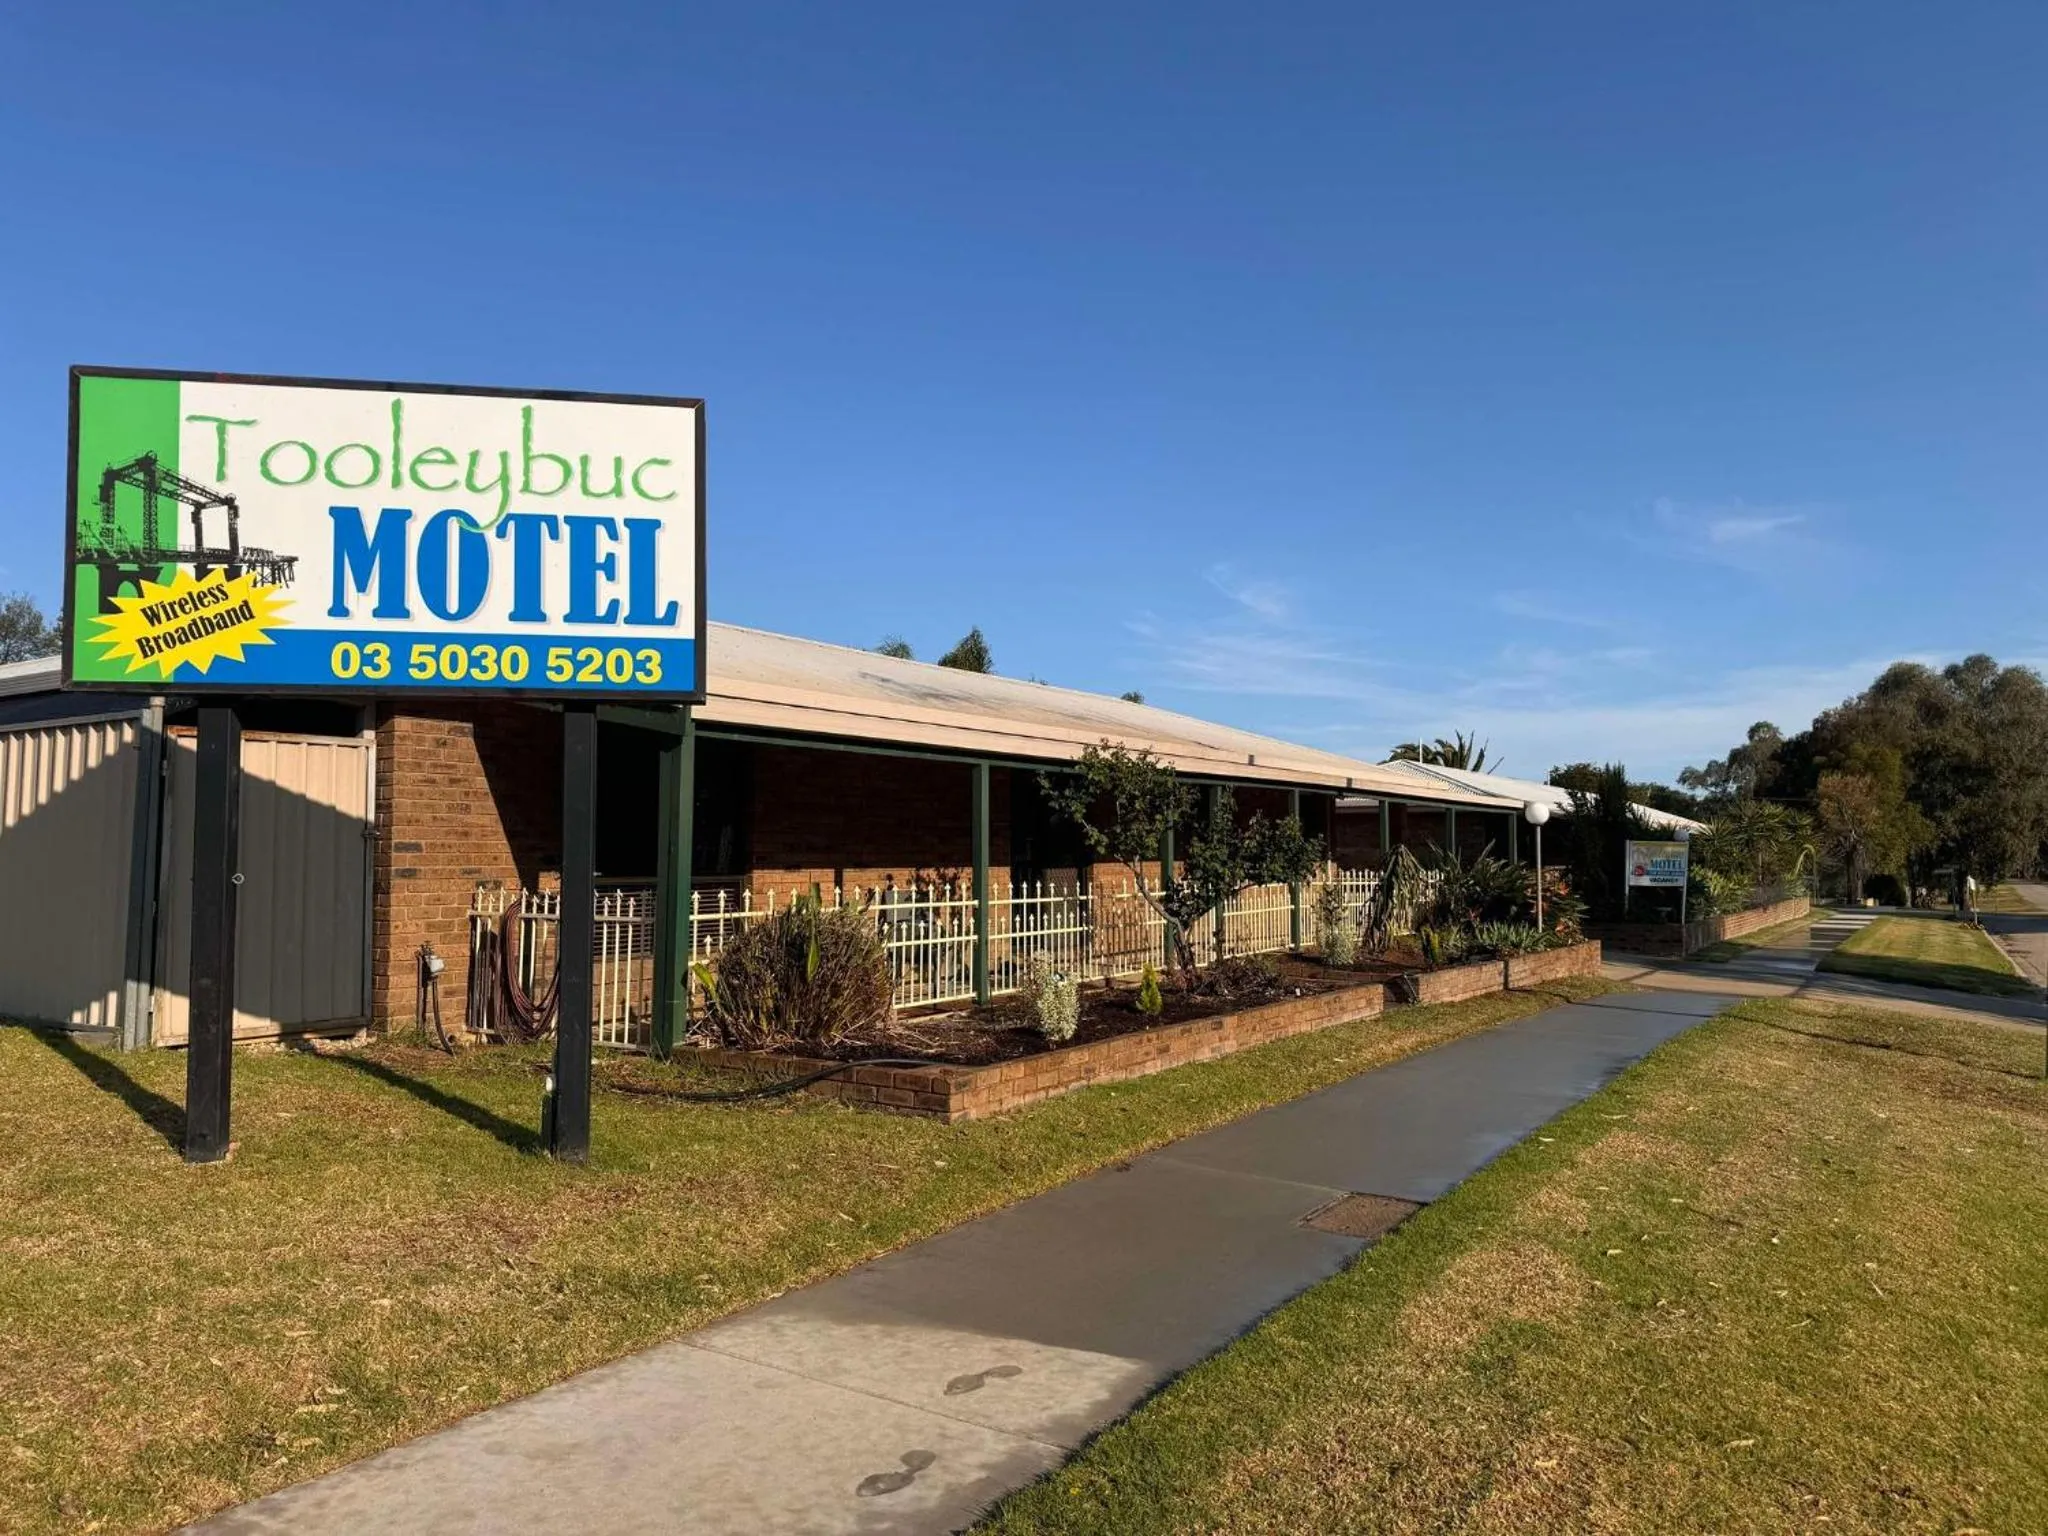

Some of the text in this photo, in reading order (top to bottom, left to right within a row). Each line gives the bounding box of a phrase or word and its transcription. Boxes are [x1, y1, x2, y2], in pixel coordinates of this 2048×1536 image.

[185, 398, 677, 532] Tooleybuc
[327, 505, 679, 625] MOTEL
[136, 600, 256, 659] Broadband
[140, 583, 229, 628] Wireless
[332, 641, 663, 684] 03 5030 5203
[1650, 858, 1683, 869] MOTEL
